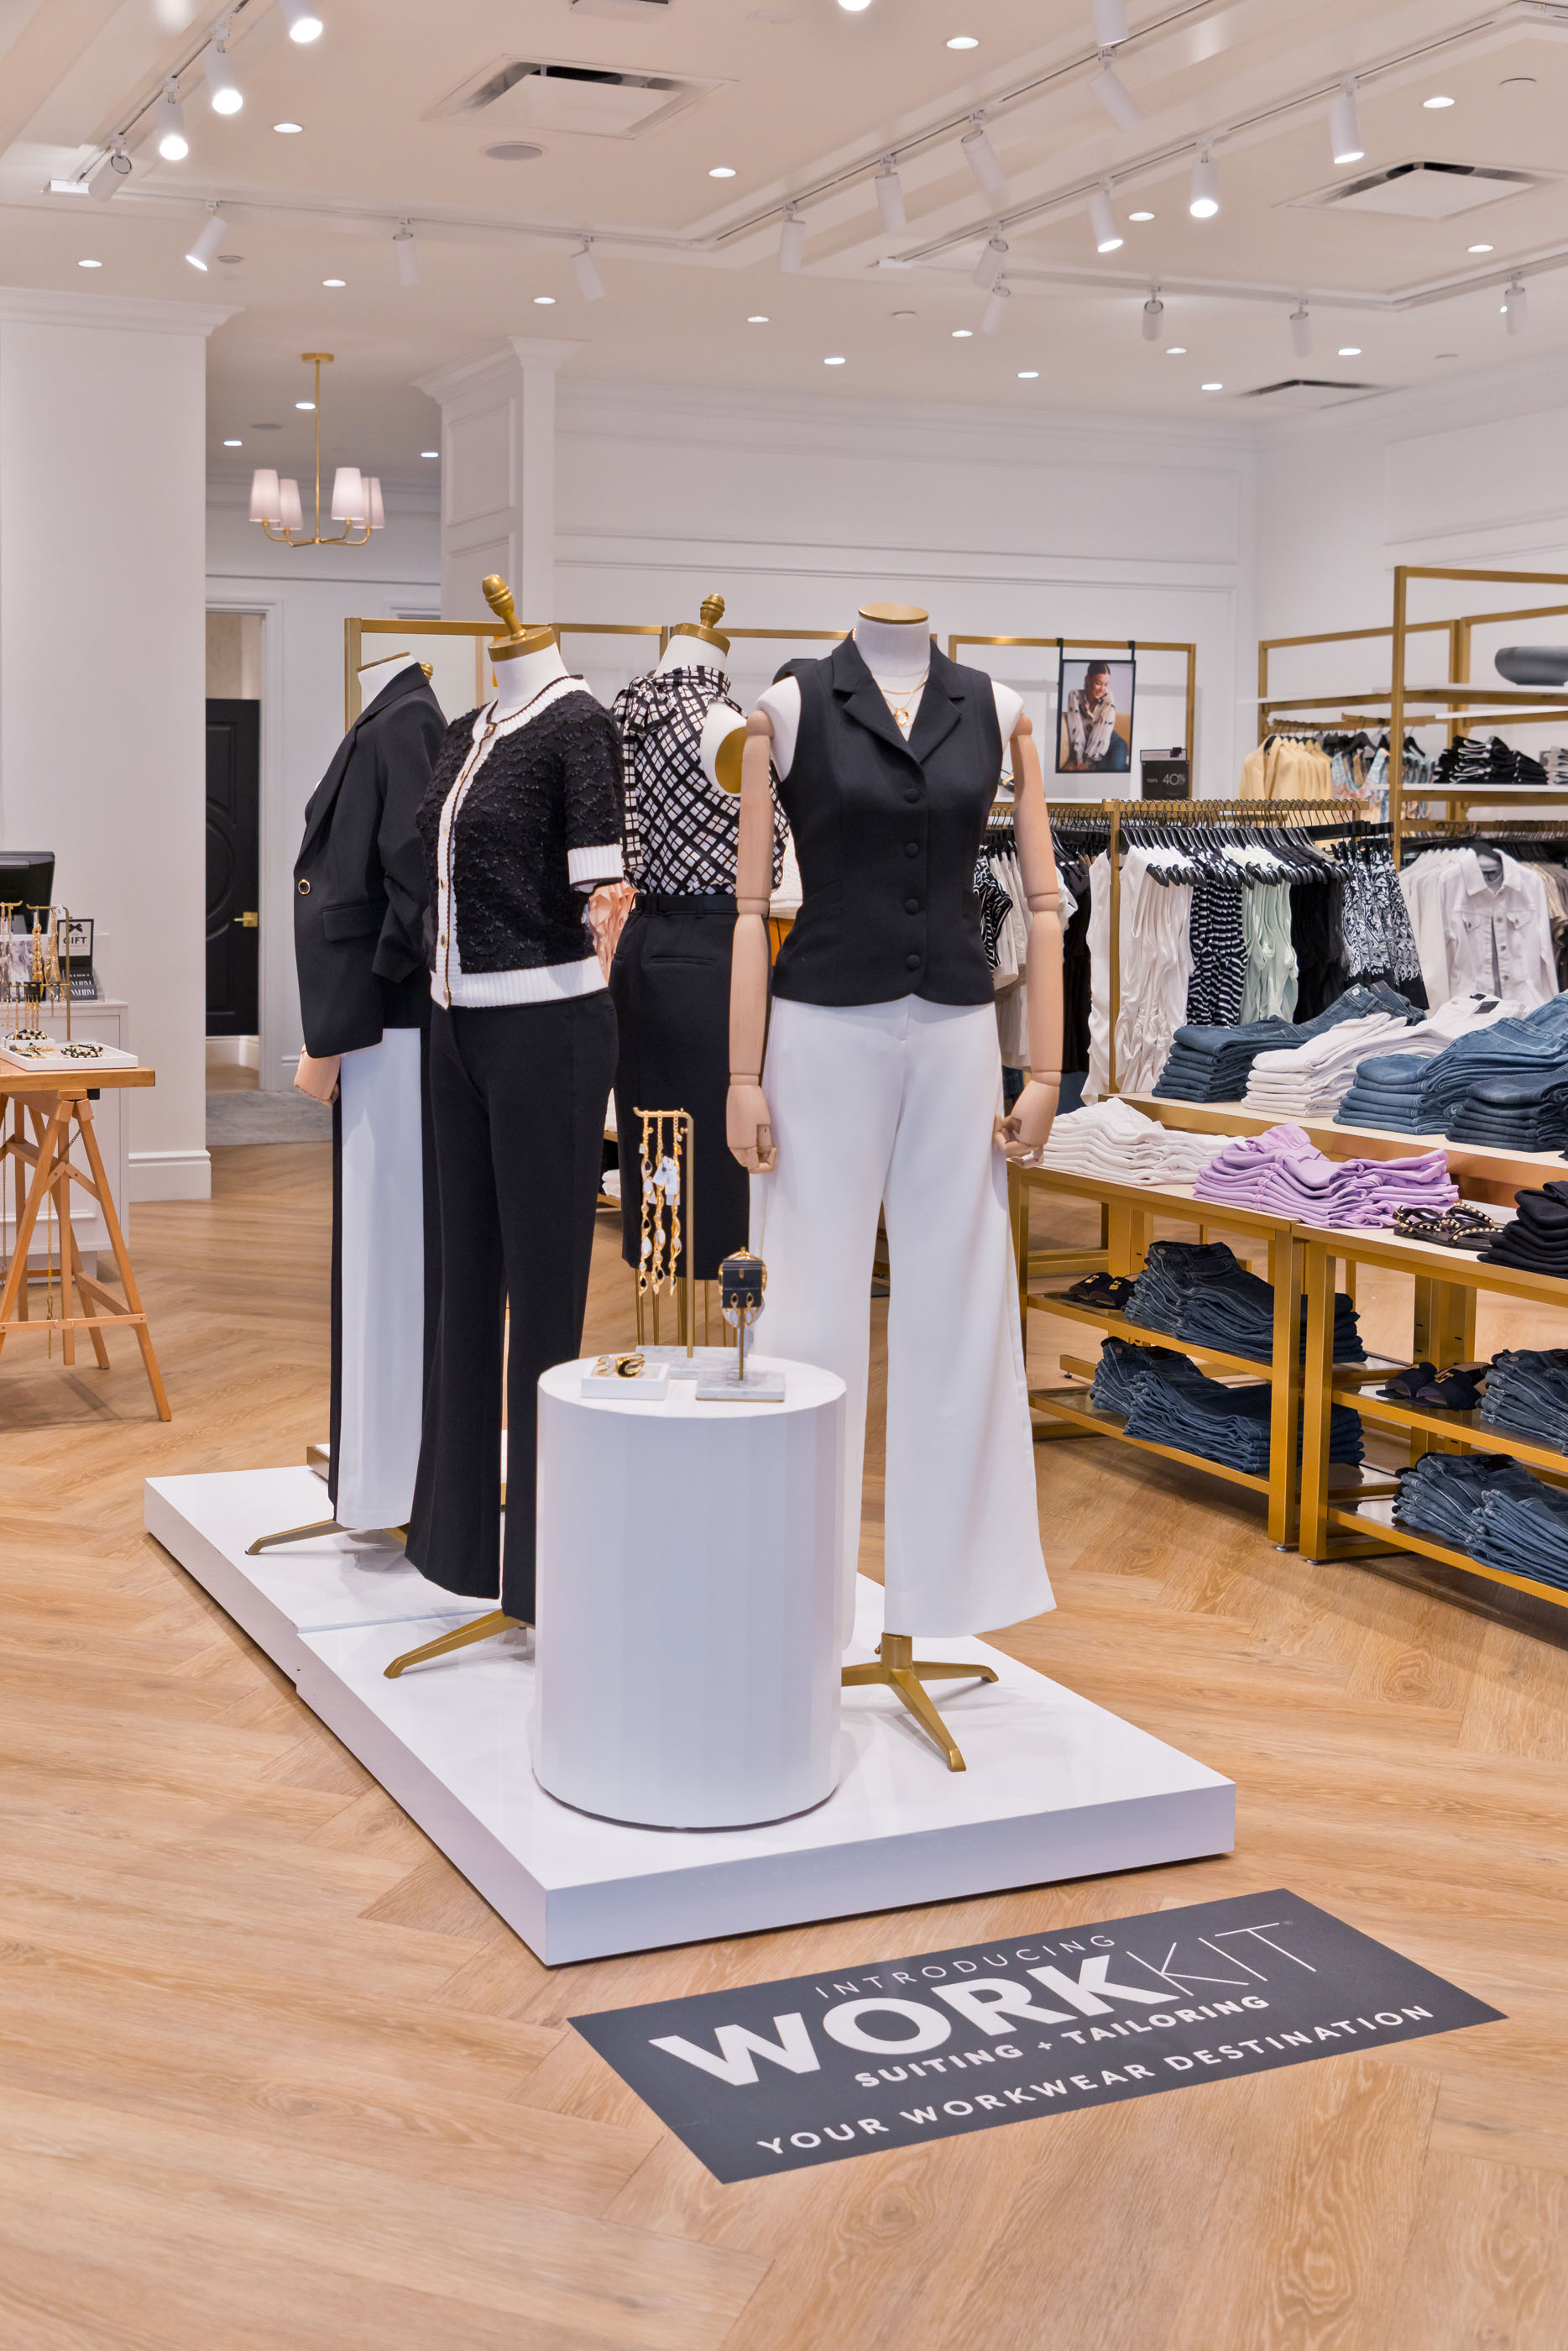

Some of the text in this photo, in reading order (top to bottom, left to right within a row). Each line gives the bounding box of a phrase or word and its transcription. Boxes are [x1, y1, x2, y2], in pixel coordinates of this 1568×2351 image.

[815, 1935, 1116, 1998] INTRODUCING
[756, 2005, 1434, 2155] YOUR WORKWEAR DESTINATION
[855, 2044, 1024, 2087] SUITING
[1060, 1995, 1270, 2045] TAILORING
